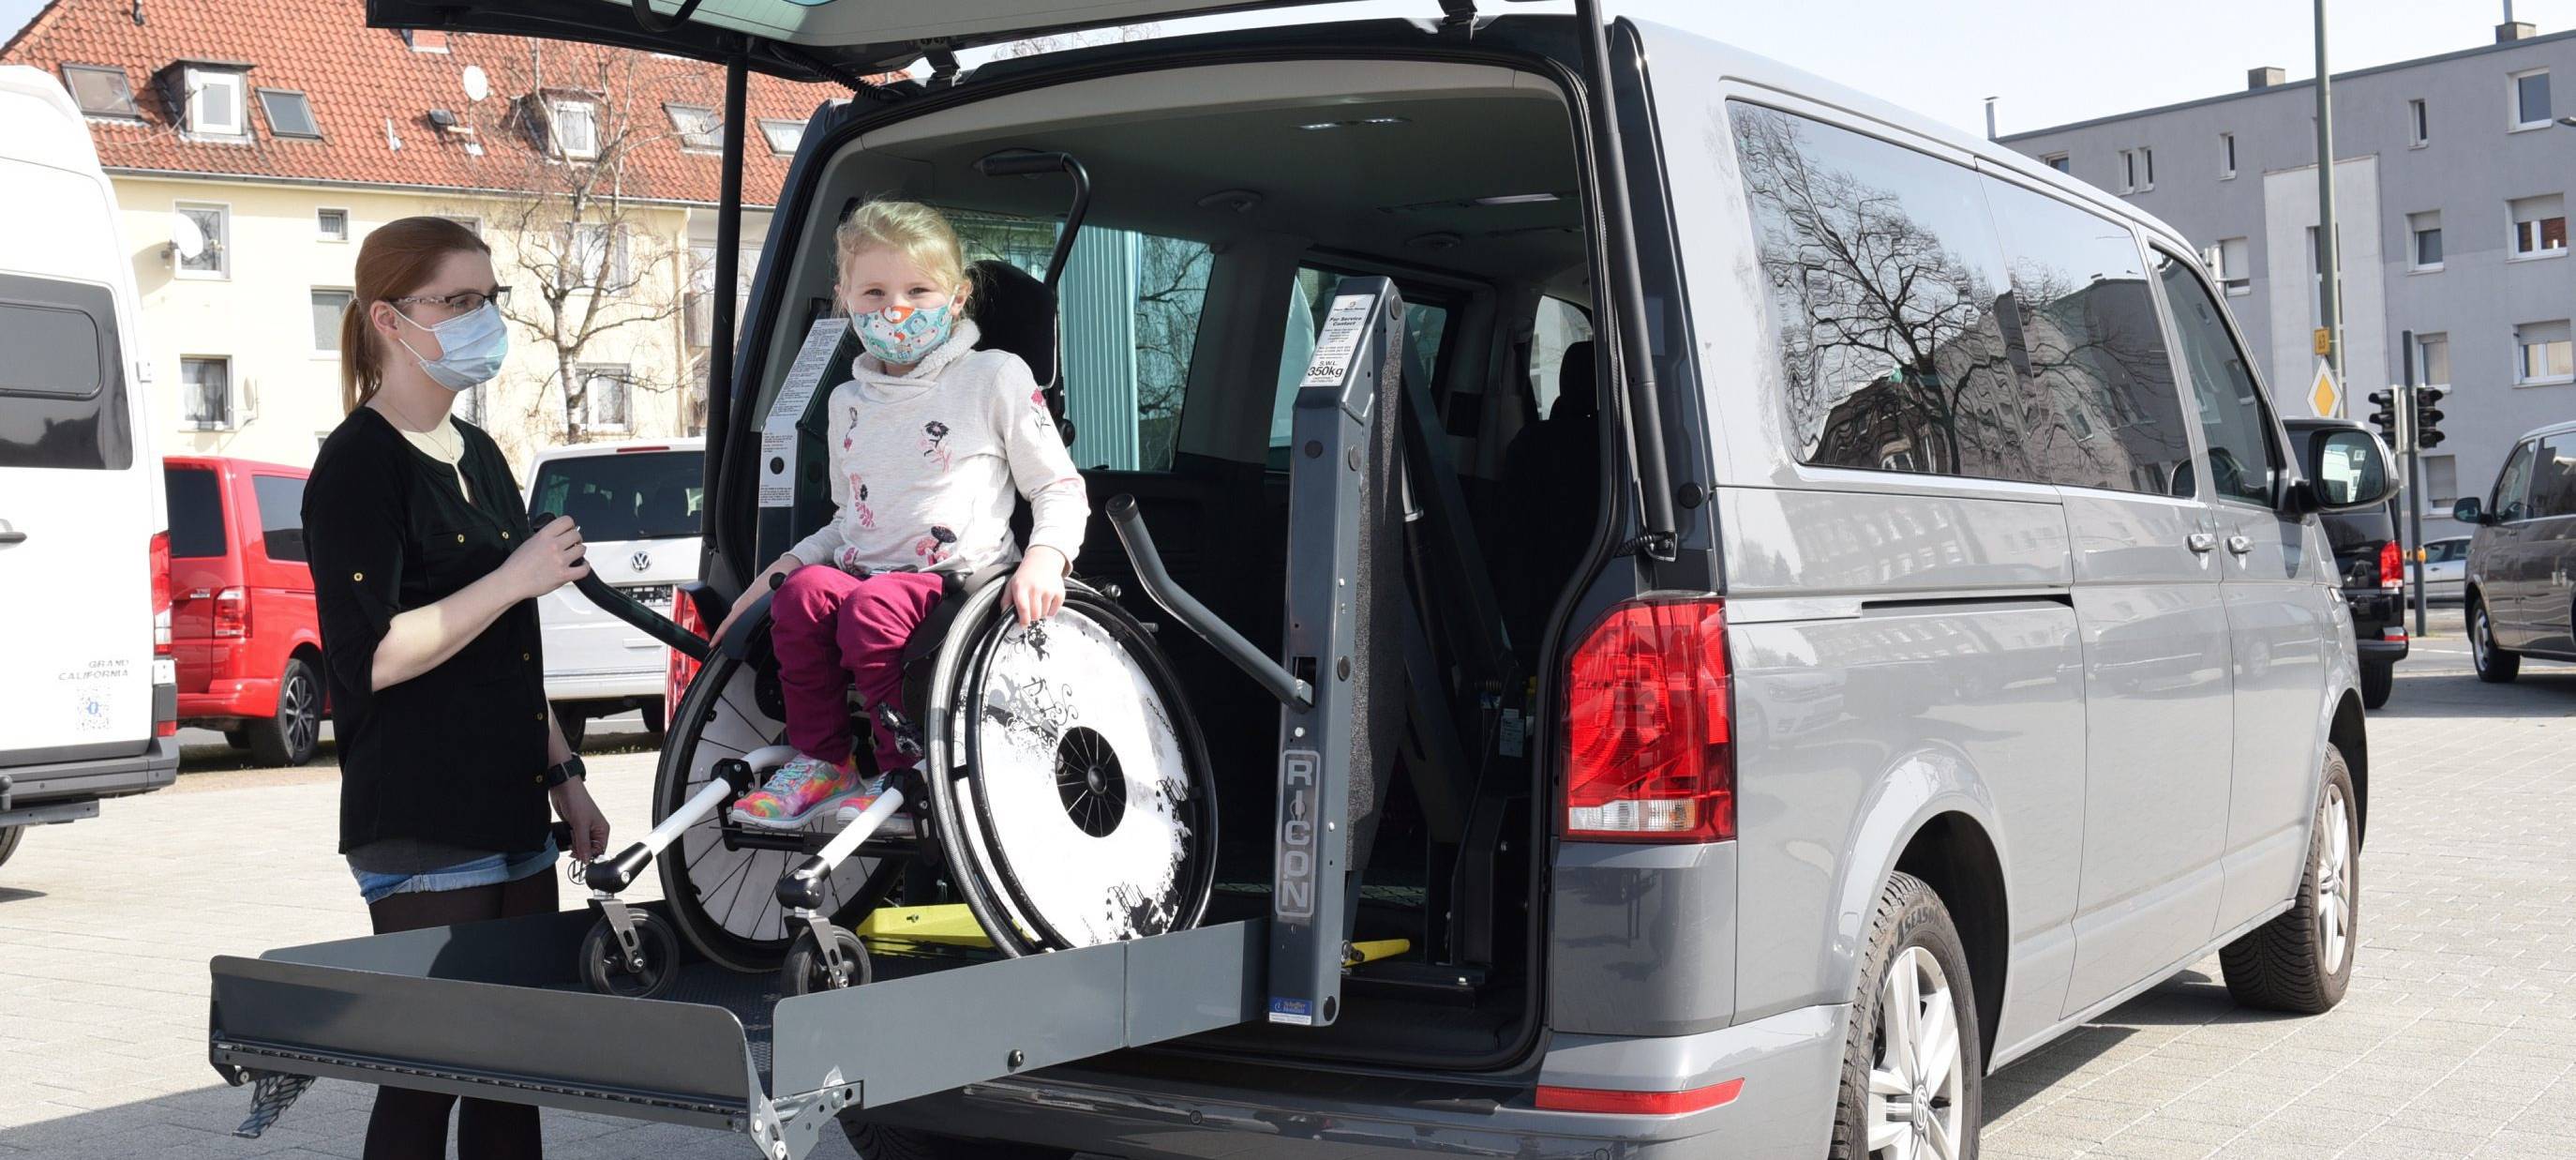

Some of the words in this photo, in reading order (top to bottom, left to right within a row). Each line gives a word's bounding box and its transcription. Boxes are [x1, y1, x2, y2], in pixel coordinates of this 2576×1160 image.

[1308, 367, 1343, 377] 350kg
[58, 670, 128, 680] CALIFORNIA
[1282, 761, 1312, 907] RICON
